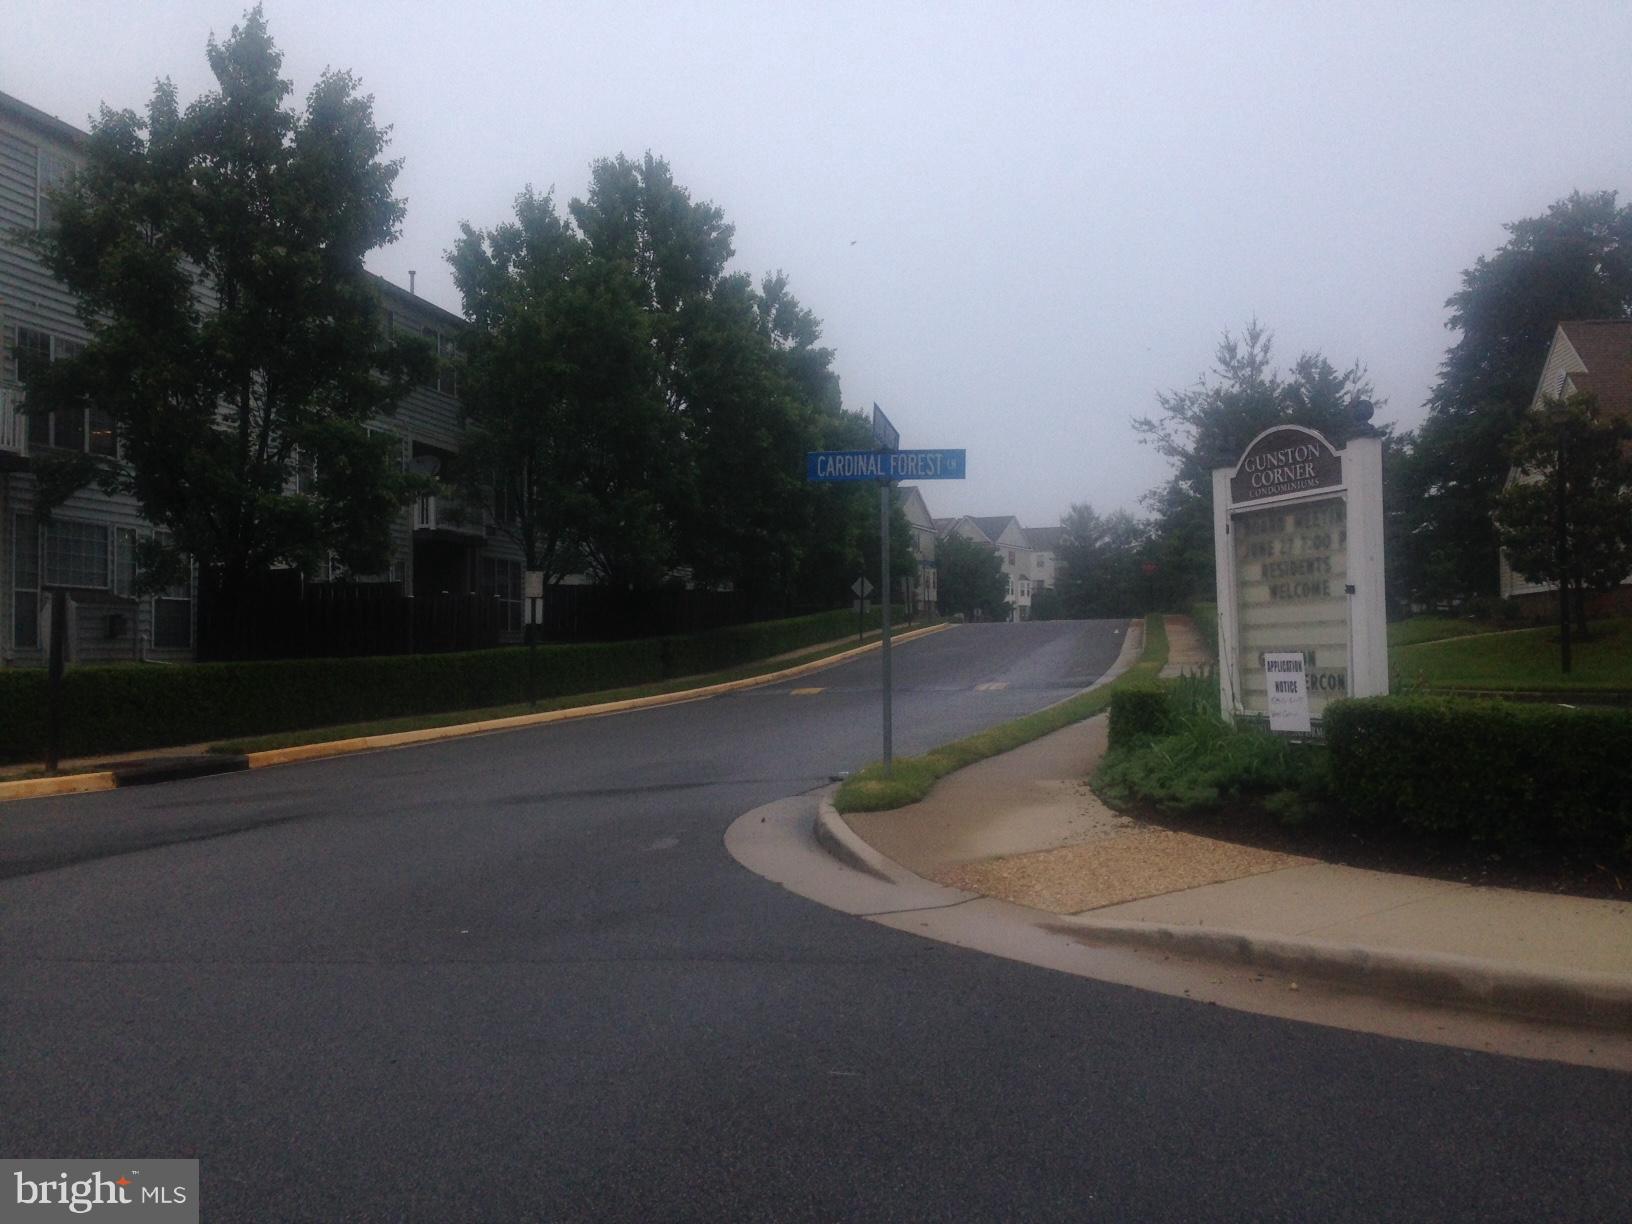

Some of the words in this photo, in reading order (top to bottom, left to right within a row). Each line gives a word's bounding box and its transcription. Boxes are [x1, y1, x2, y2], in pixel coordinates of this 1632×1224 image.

[817, 455, 885, 477] CARDINAL
[890, 454, 944, 476] FOREST
[1244, 443, 1320, 473] GUNSTON
[1251, 462, 1316, 488] CORNER
[1248, 478, 1320, 497] CONDOMINIUMS
[1266, 660, 1303, 673] APPLICATION
[1275, 681, 1298, 693] NOTICE
